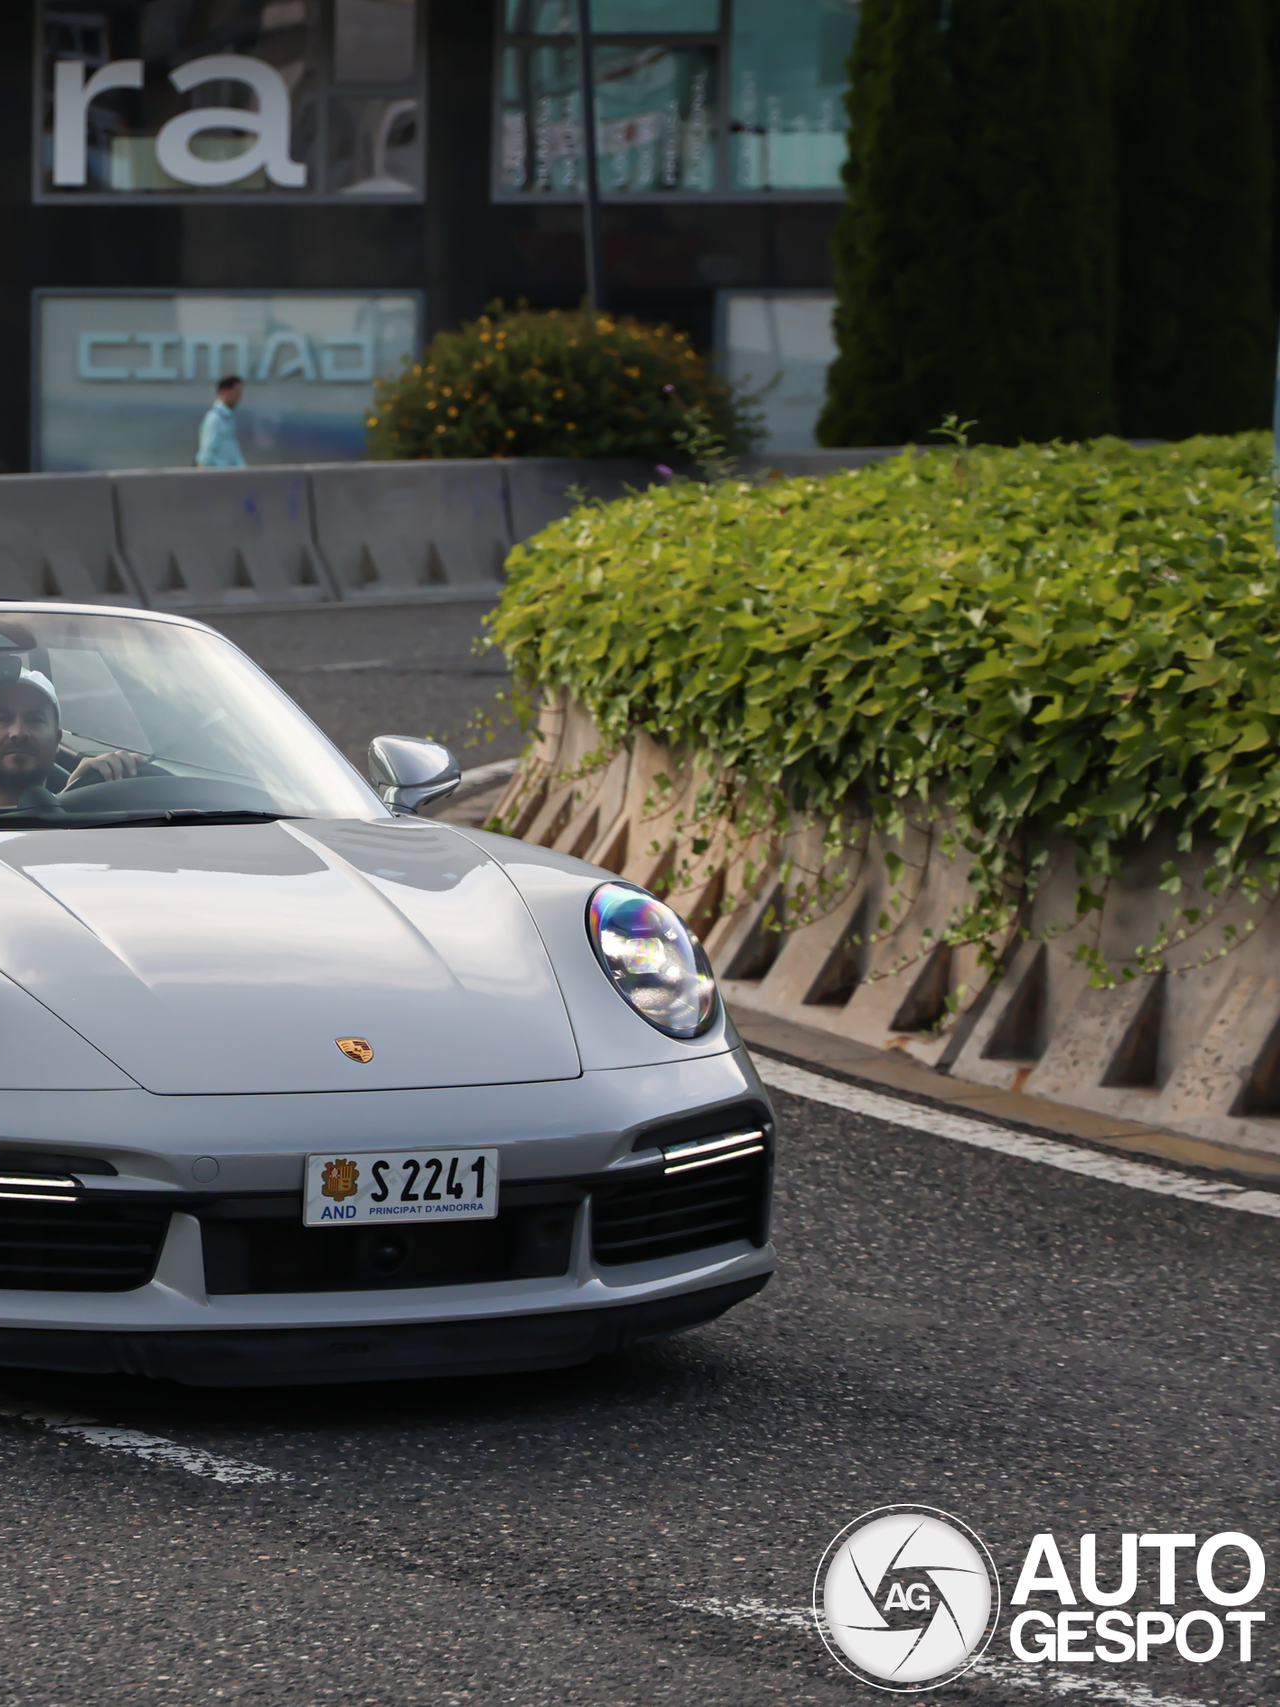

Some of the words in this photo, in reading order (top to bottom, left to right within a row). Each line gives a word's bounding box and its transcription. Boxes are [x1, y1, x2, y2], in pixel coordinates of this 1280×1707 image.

[80, 332, 374, 381] CIMAD
[370, 1160, 390, 1202] S
[400, 1156, 485, 1201] 2241
[320, 1205, 357, 1220] AND
[369, 1205, 422, 1216] PRINCIPAT
[425, 1202, 484, 1213] D'ANDORRA
